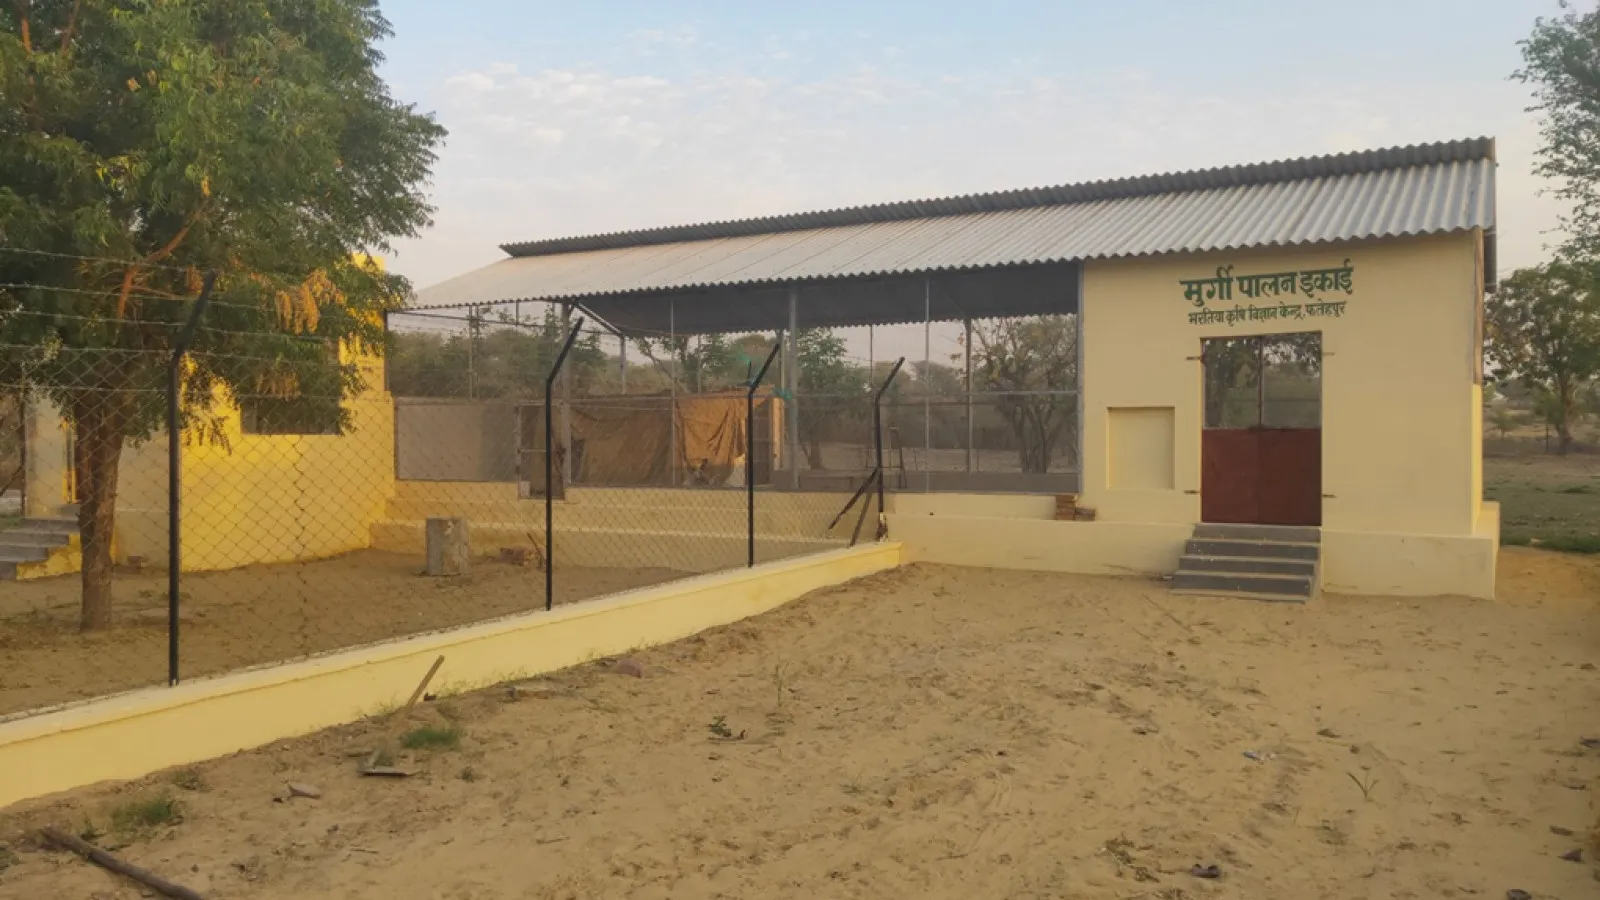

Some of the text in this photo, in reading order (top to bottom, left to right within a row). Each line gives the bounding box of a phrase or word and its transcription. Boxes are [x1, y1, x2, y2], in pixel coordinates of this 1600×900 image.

[1179, 258, 1354, 307] मुर्गी पालन इकाई
[1225, 304, 1246, 328] कृषि
[1248, 303, 1278, 323] विज्ञान
[1305, 298, 1348, 318] फतेहपुर
